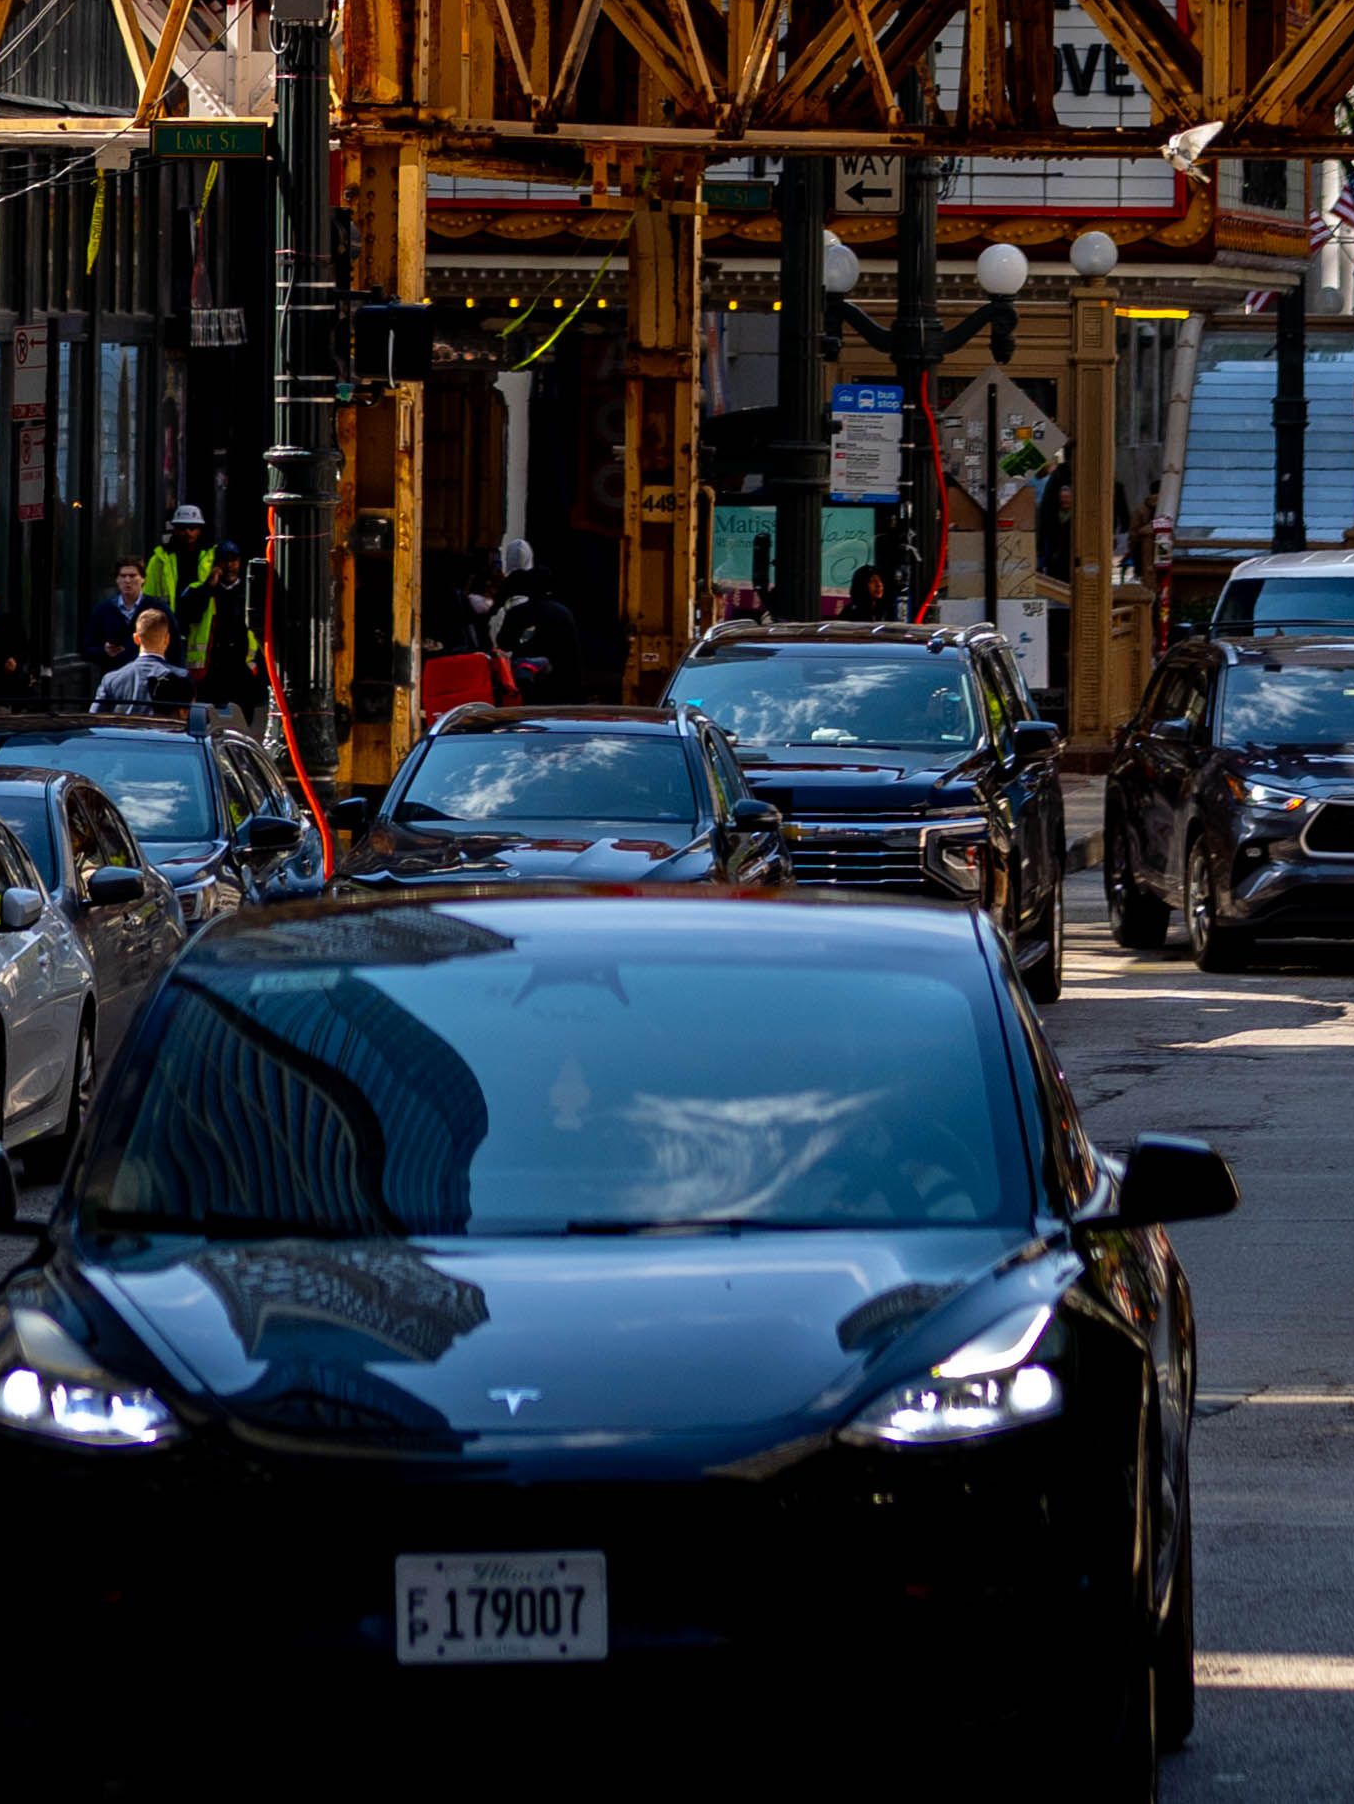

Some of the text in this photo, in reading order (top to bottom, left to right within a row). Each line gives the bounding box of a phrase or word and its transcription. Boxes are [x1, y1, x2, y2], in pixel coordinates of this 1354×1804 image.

[840, 155, 895, 176] WAY
[876, 390, 897, 400] bus
[876, 399, 901, 411] stop
[444, 1586, 586, 1641] 179007
